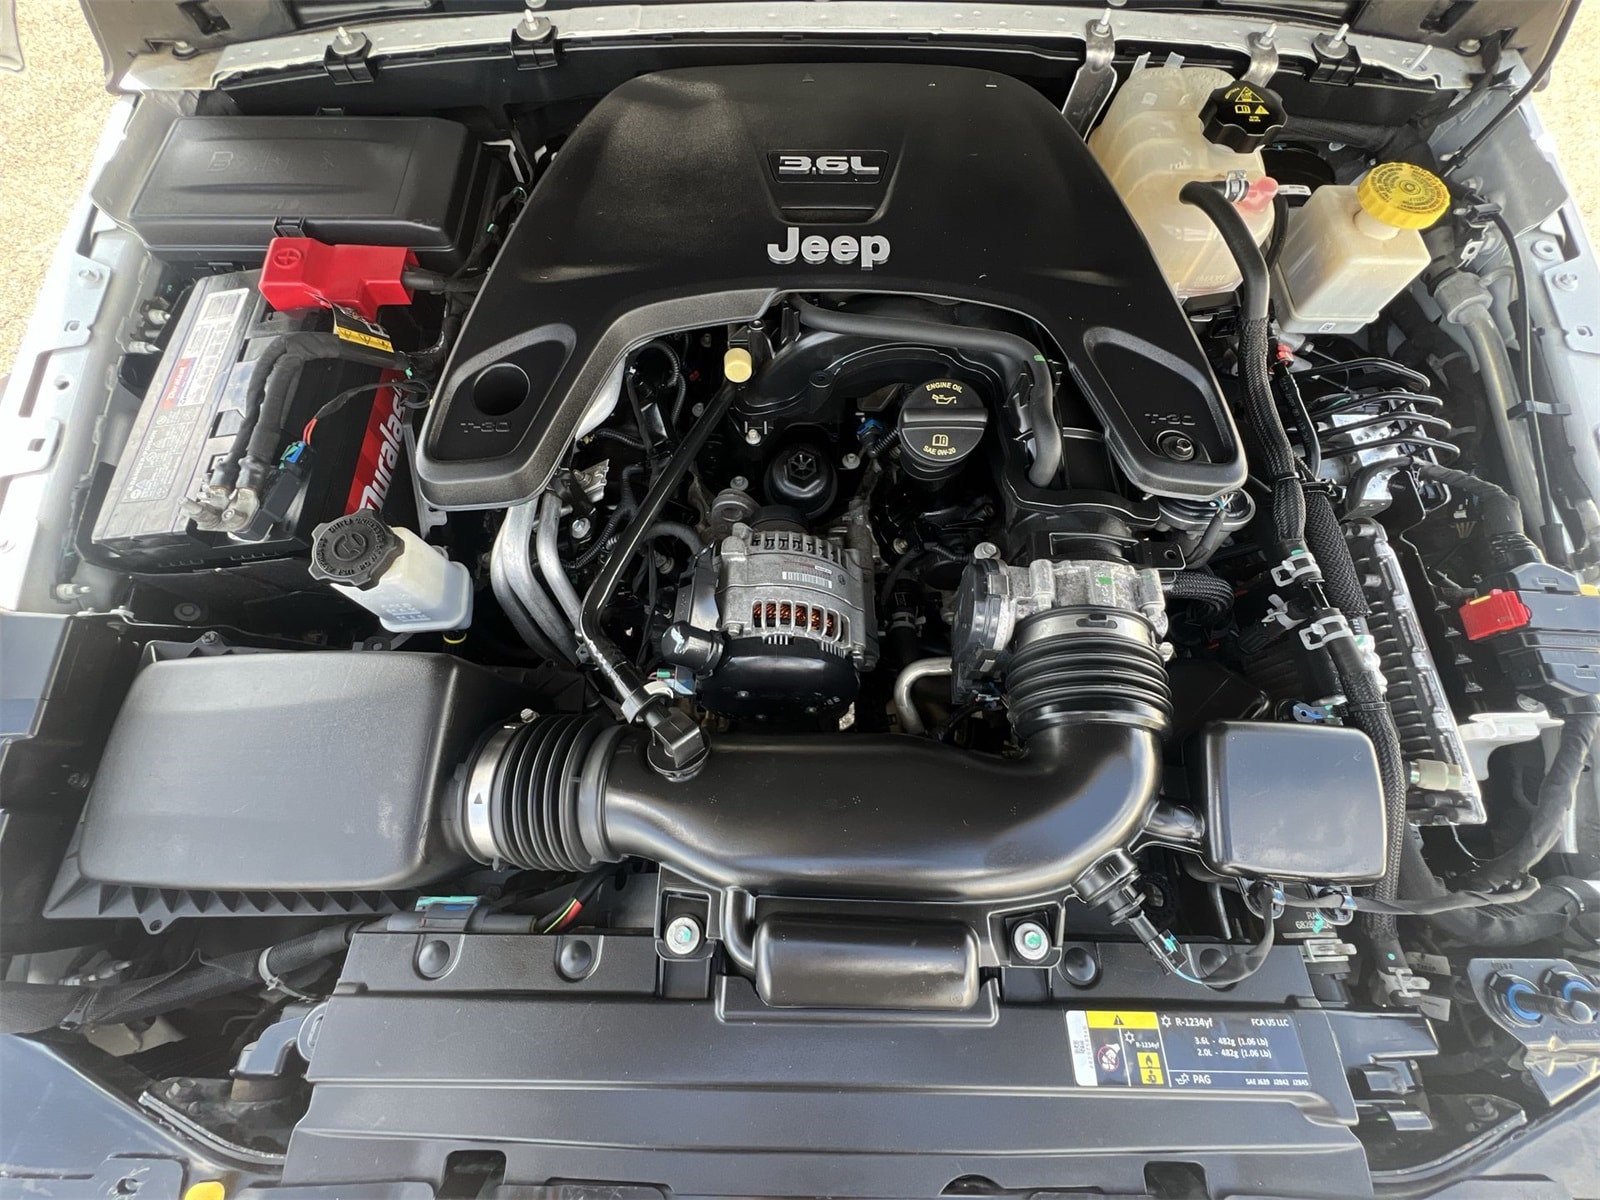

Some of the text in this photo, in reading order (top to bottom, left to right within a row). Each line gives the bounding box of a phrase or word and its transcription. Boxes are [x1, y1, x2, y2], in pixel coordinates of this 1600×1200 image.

[779, 155, 880, 175] 3.6L
[767, 227, 891, 271] Jeep
[925, 381, 963, 394] ENGINE OIL
[923, 445, 957, 456] SAE 0W-20
[1175, 1017, 1213, 1029] R-1234yf
[1251, 1018, 1289, 1027] FCA US LLC
[1194, 1036, 1210, 1045] 3.6L
[1218, 1037, 1236, 1047] 482g
[1238, 1037, 1257, 1047] (1.06
[1257, 1037, 1269, 1047] Lb)
[1197, 1048, 1213, 1057] 2.0L
[1221, 1049, 1240, 1059] 482g
[1242, 1049, 1260, 1059] (1.06
[1260, 1049, 1272, 1059] Lb)
[1193, 1074, 1212, 1085] PAG
